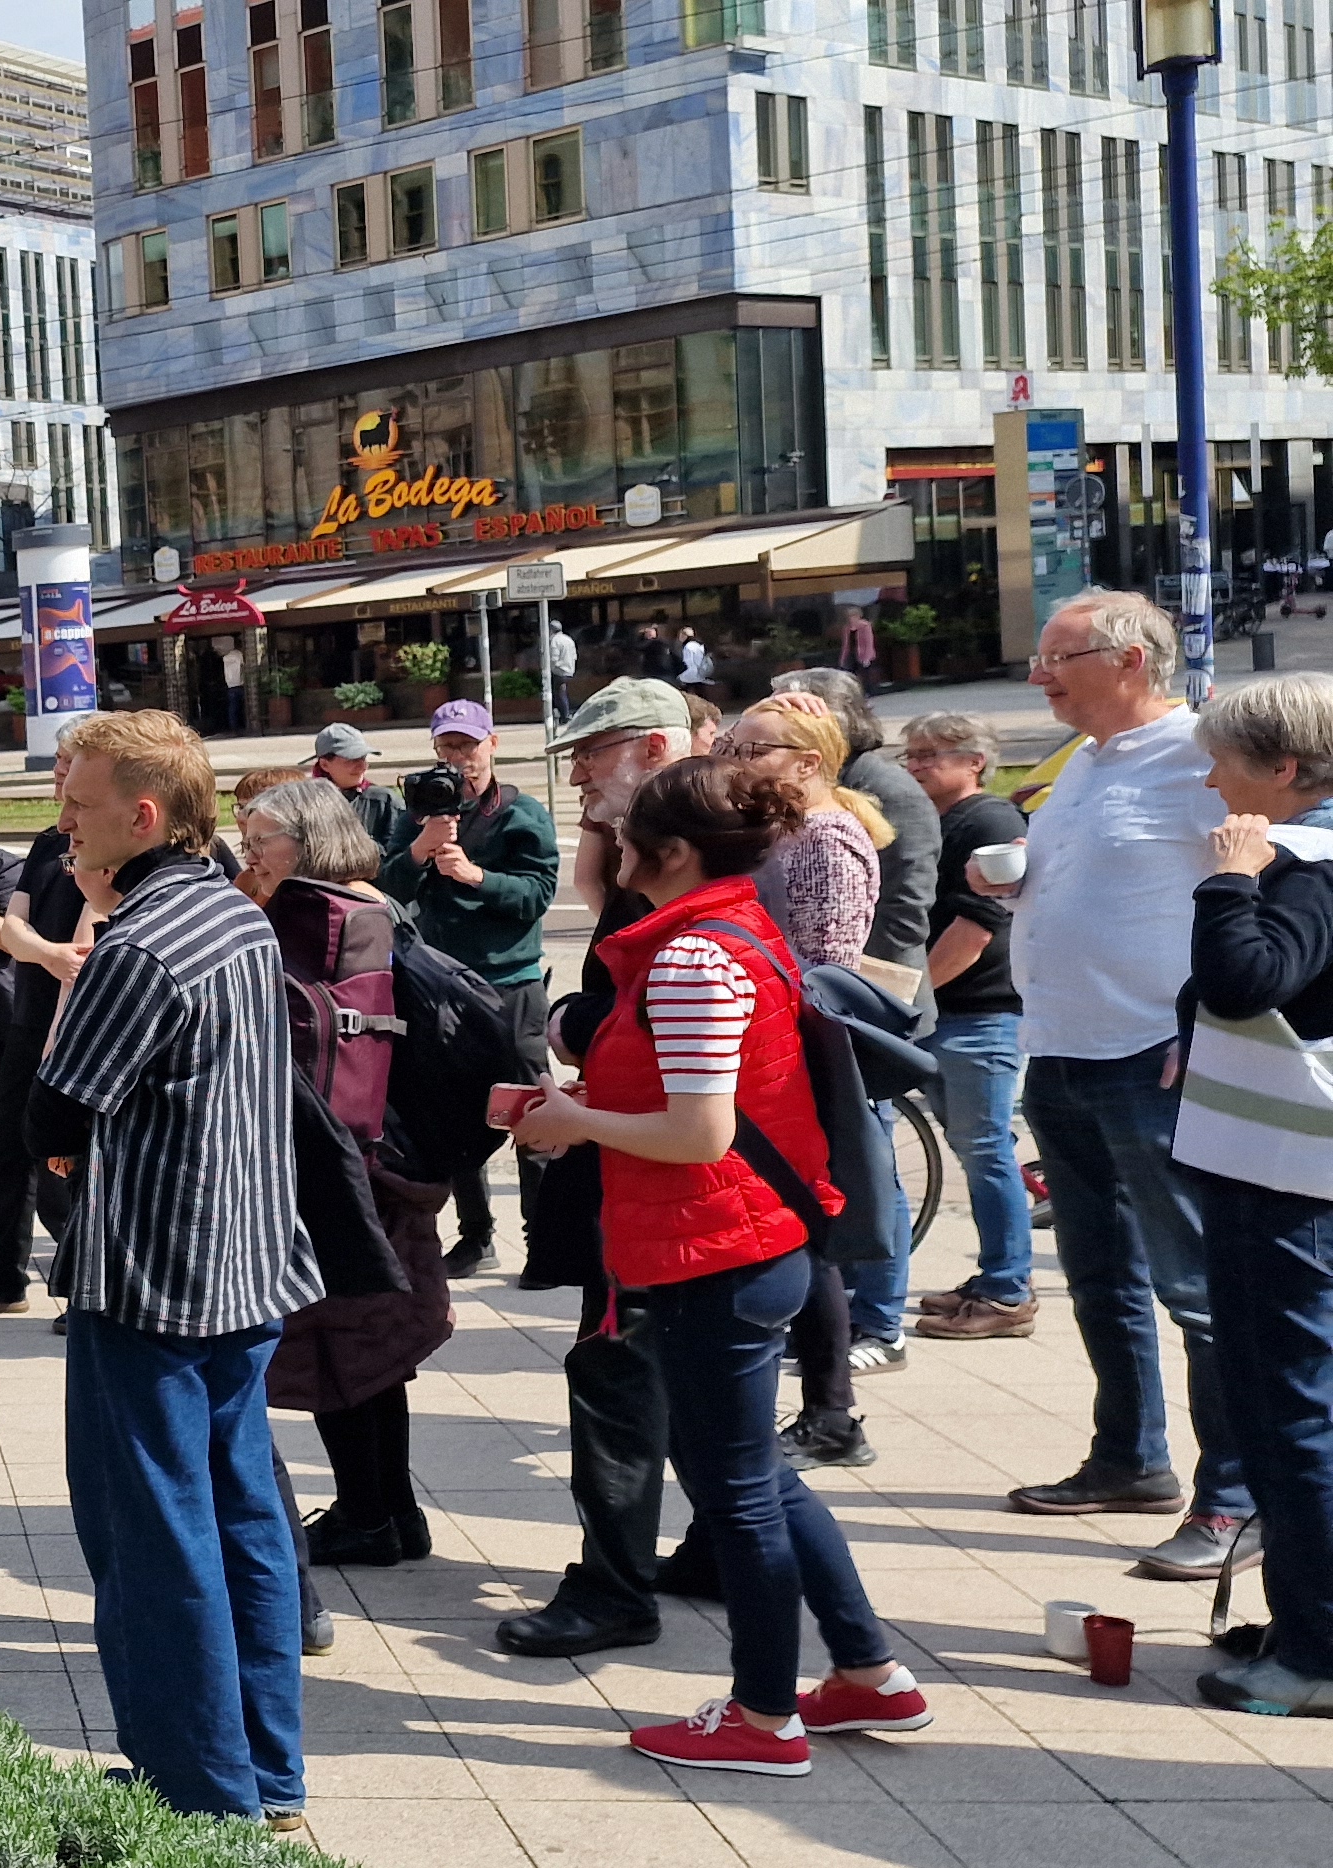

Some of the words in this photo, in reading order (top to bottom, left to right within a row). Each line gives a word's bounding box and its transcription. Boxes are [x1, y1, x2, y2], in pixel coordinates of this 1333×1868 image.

[310, 484, 361, 540] La
[365, 464, 502, 520] Bodega
[193, 536, 344, 575] RESTAURANTE
[368, 521, 444, 553] TAPAS
[473, 503, 605, 542] ESPAÑOL
[516, 567, 553, 580] Radfahrer
[516, 582, 556, 597] absteigen
[178, 600, 198, 616] La
[199, 598, 238, 614] Bodega
[389, 599, 457, 613] RESTAURANTE
